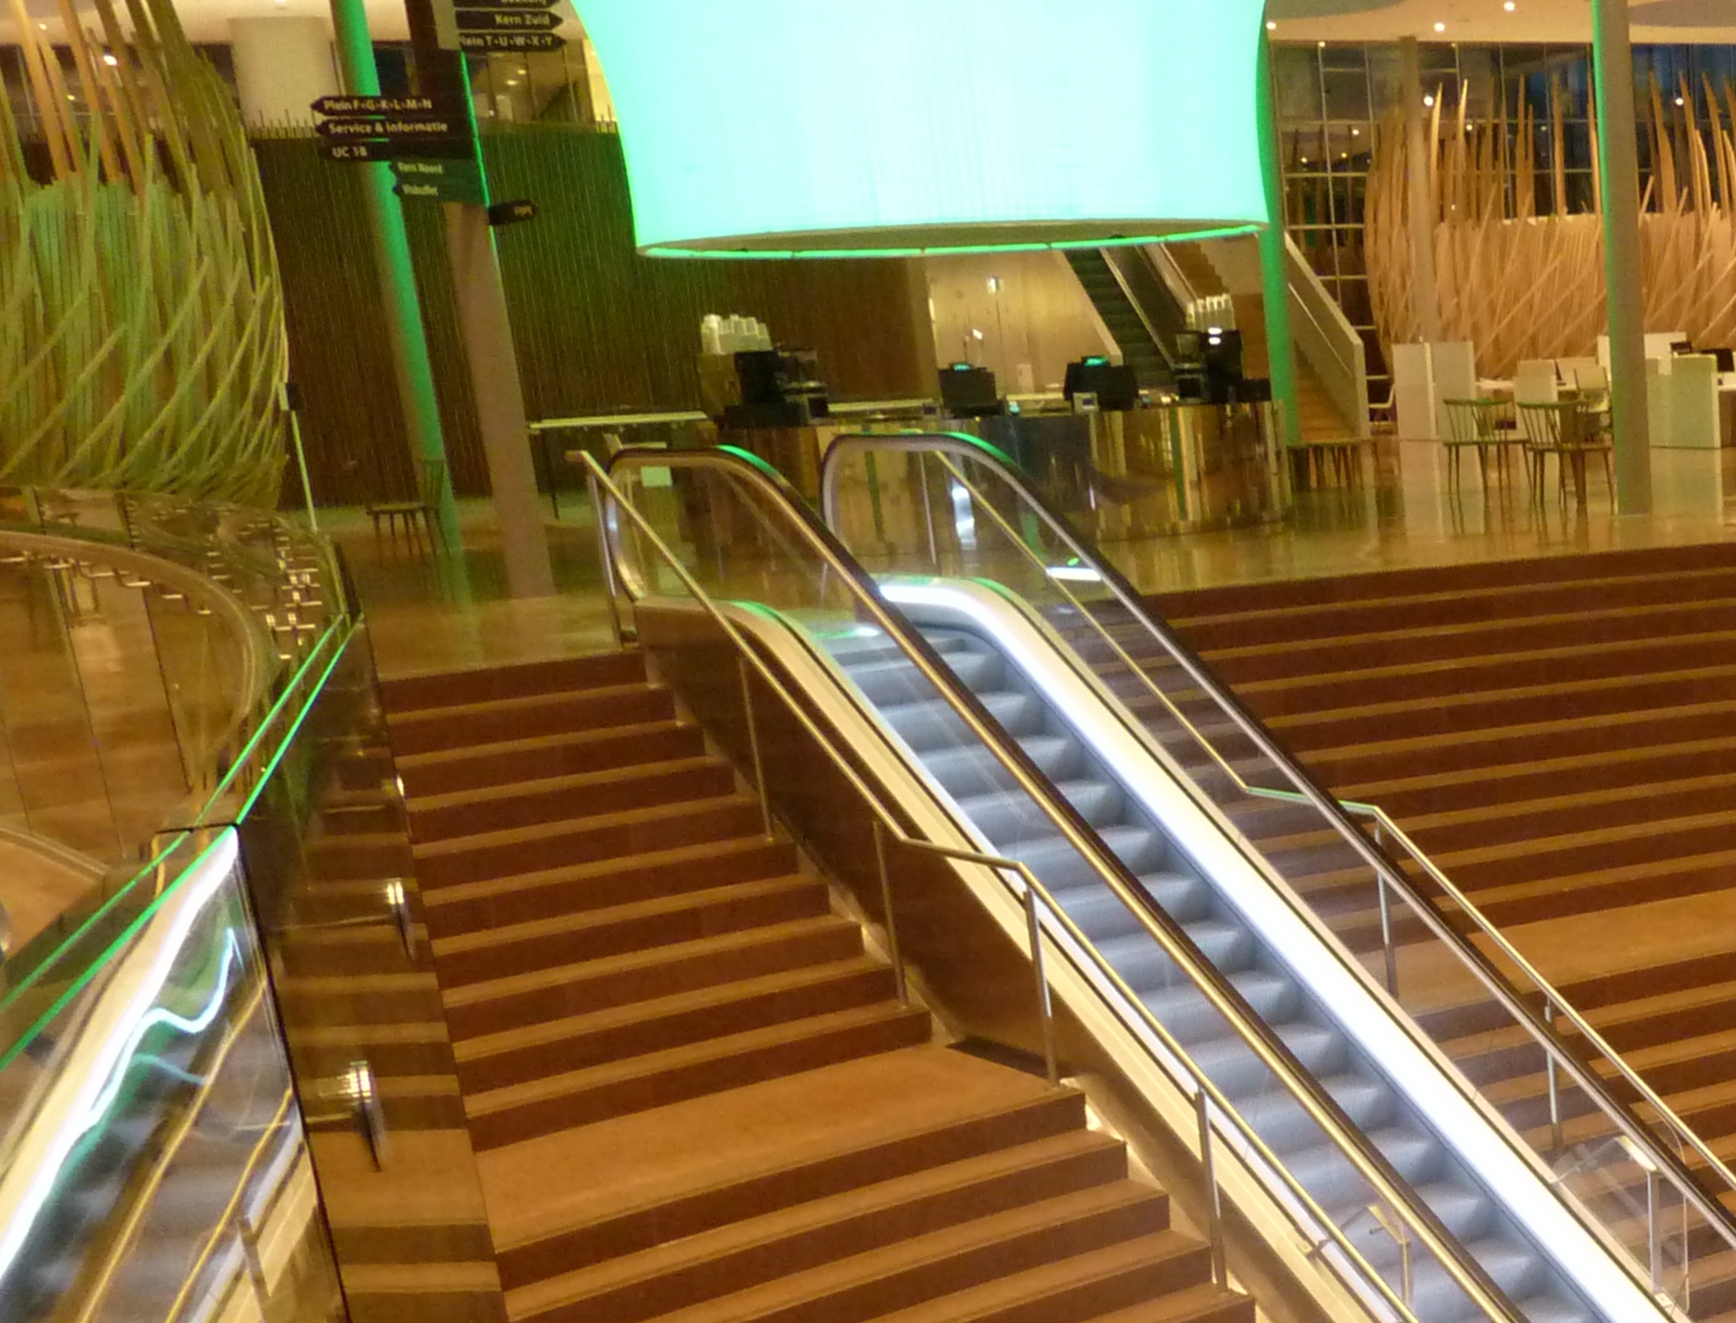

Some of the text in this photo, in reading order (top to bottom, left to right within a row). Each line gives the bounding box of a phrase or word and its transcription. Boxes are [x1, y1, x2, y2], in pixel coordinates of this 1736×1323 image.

[495, 13, 550, 25] Kern Zuid
[460, 34, 485, 47] lein
[324, 99, 352, 111] Plein
[328, 120, 449, 134] Service & Informatie
[332, 146, 350, 158] UC
